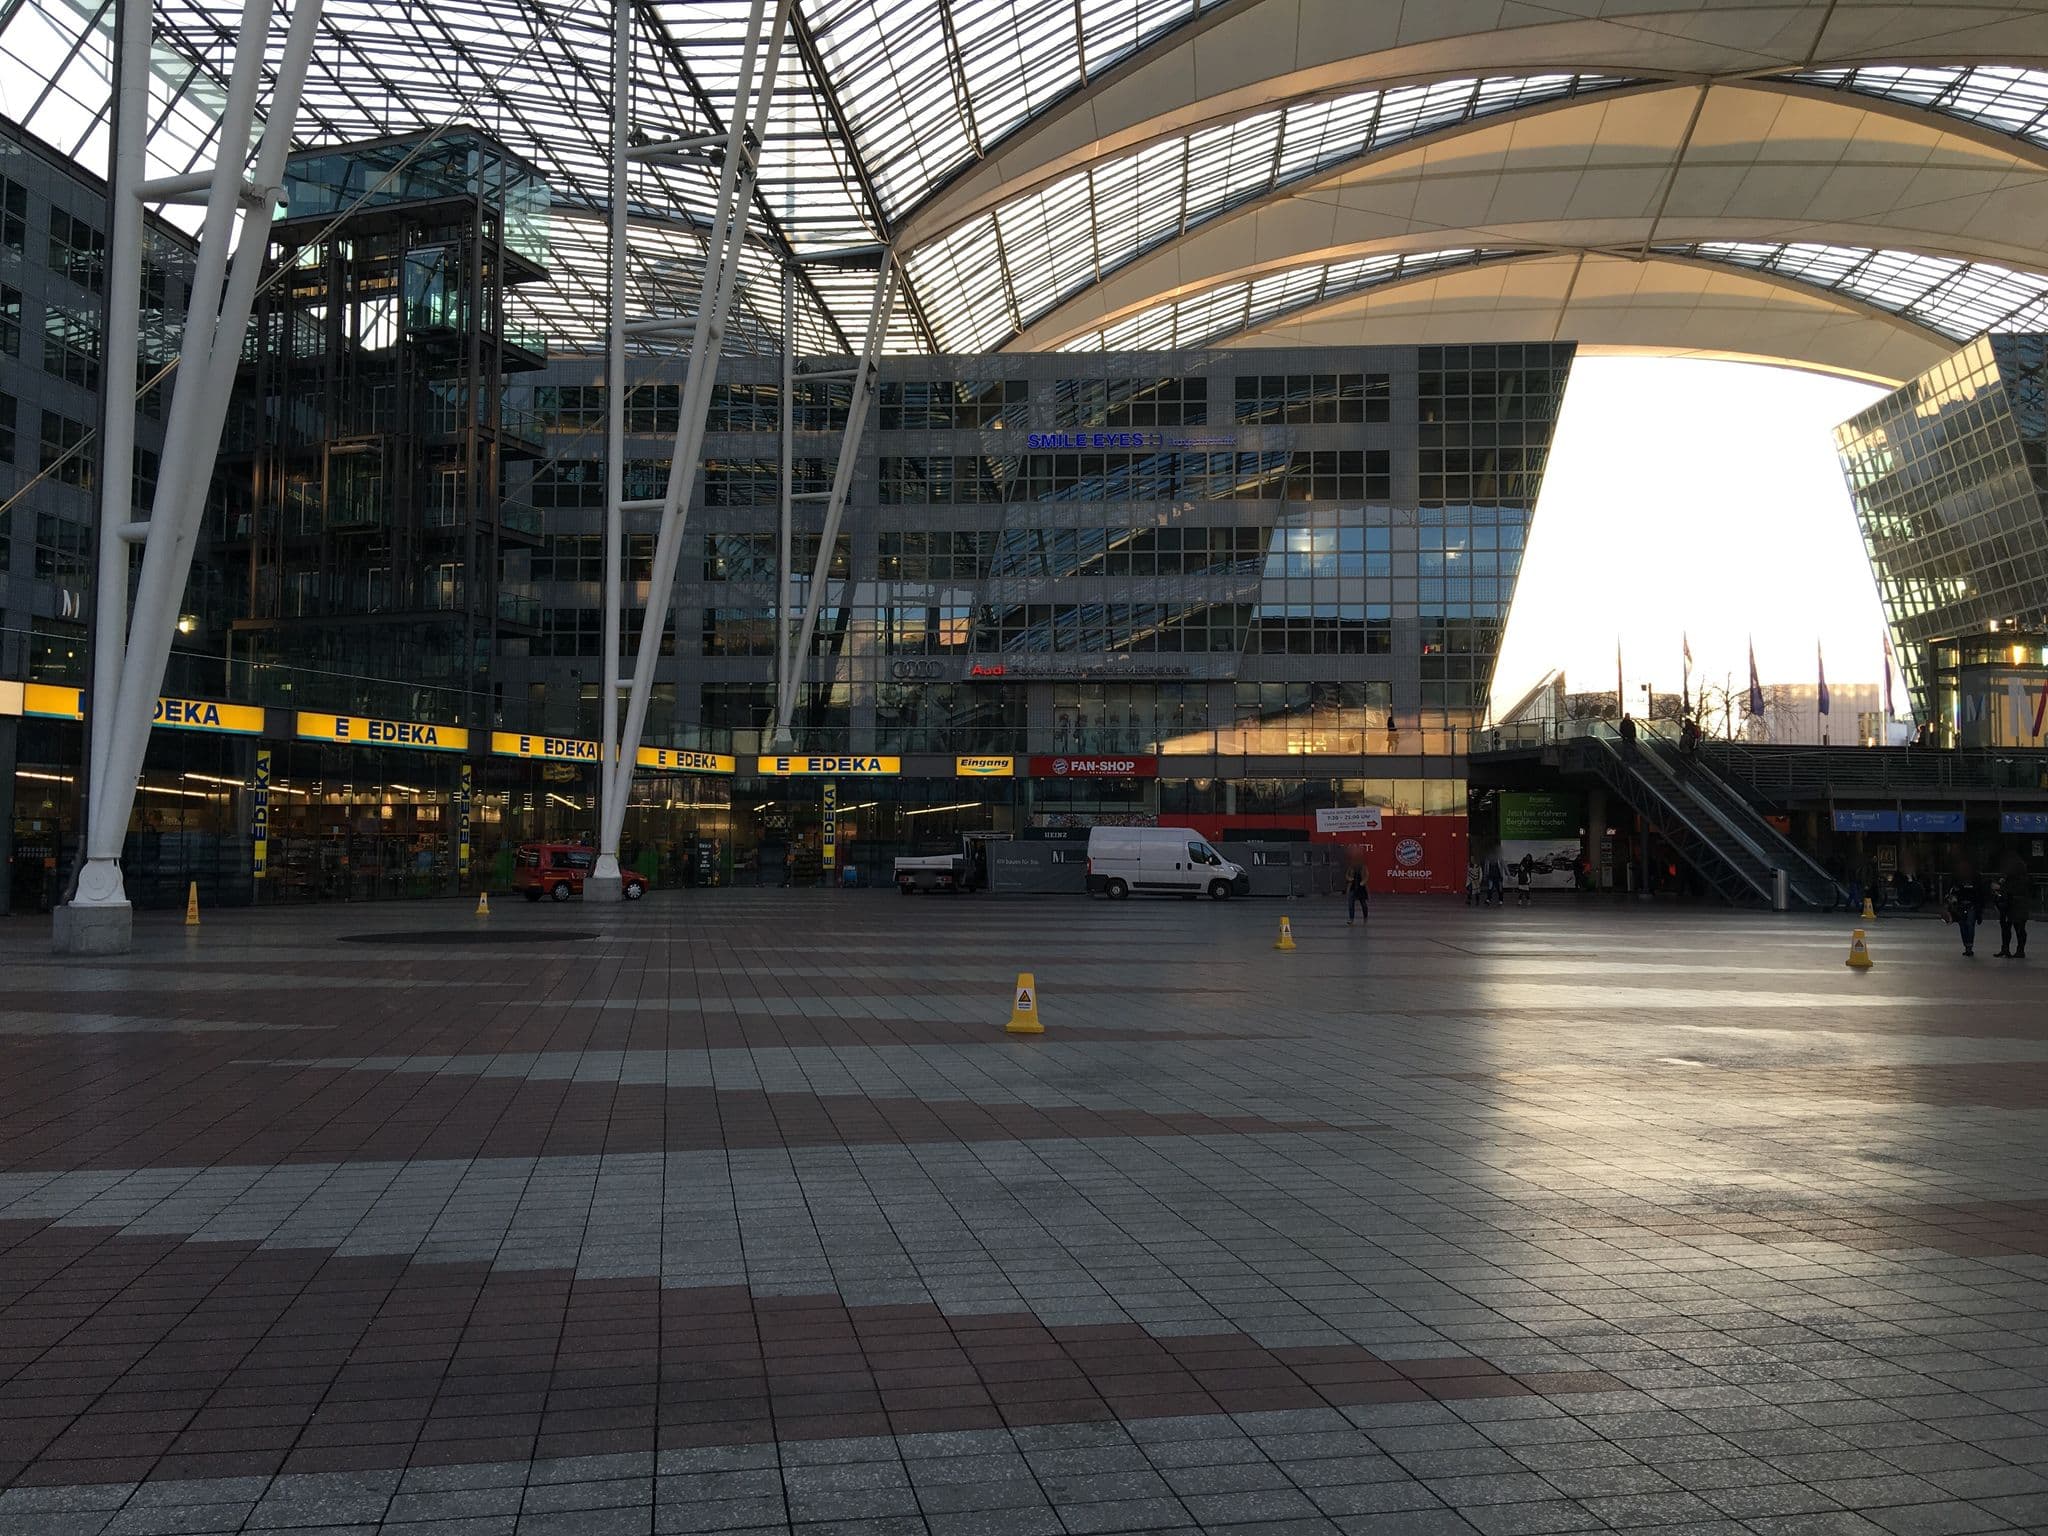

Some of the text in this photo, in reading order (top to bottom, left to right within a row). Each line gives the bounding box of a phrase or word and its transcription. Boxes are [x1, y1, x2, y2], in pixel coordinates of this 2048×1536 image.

[1028, 433, 1087, 448] SMILE
[1093, 433, 1144, 448] EYES
[971, 664, 1005, 676] Audi
[368, 721, 438, 745] EDEKA
[544, 738, 596, 758] EDEKA
[676, 752, 718, 769] EDEKA
[808, 758, 882, 771] EDEKA
[960, 758, 1009, 768] Eingang
[1071, 761, 1135, 771] FAN-SHOP
[254, 757, 270, 841] EDEKA
[459, 772, 472, 843] EDEKA
[824, 789, 835, 845] EDEKA
[1387, 869, 1432, 877] FAN-SHOP
